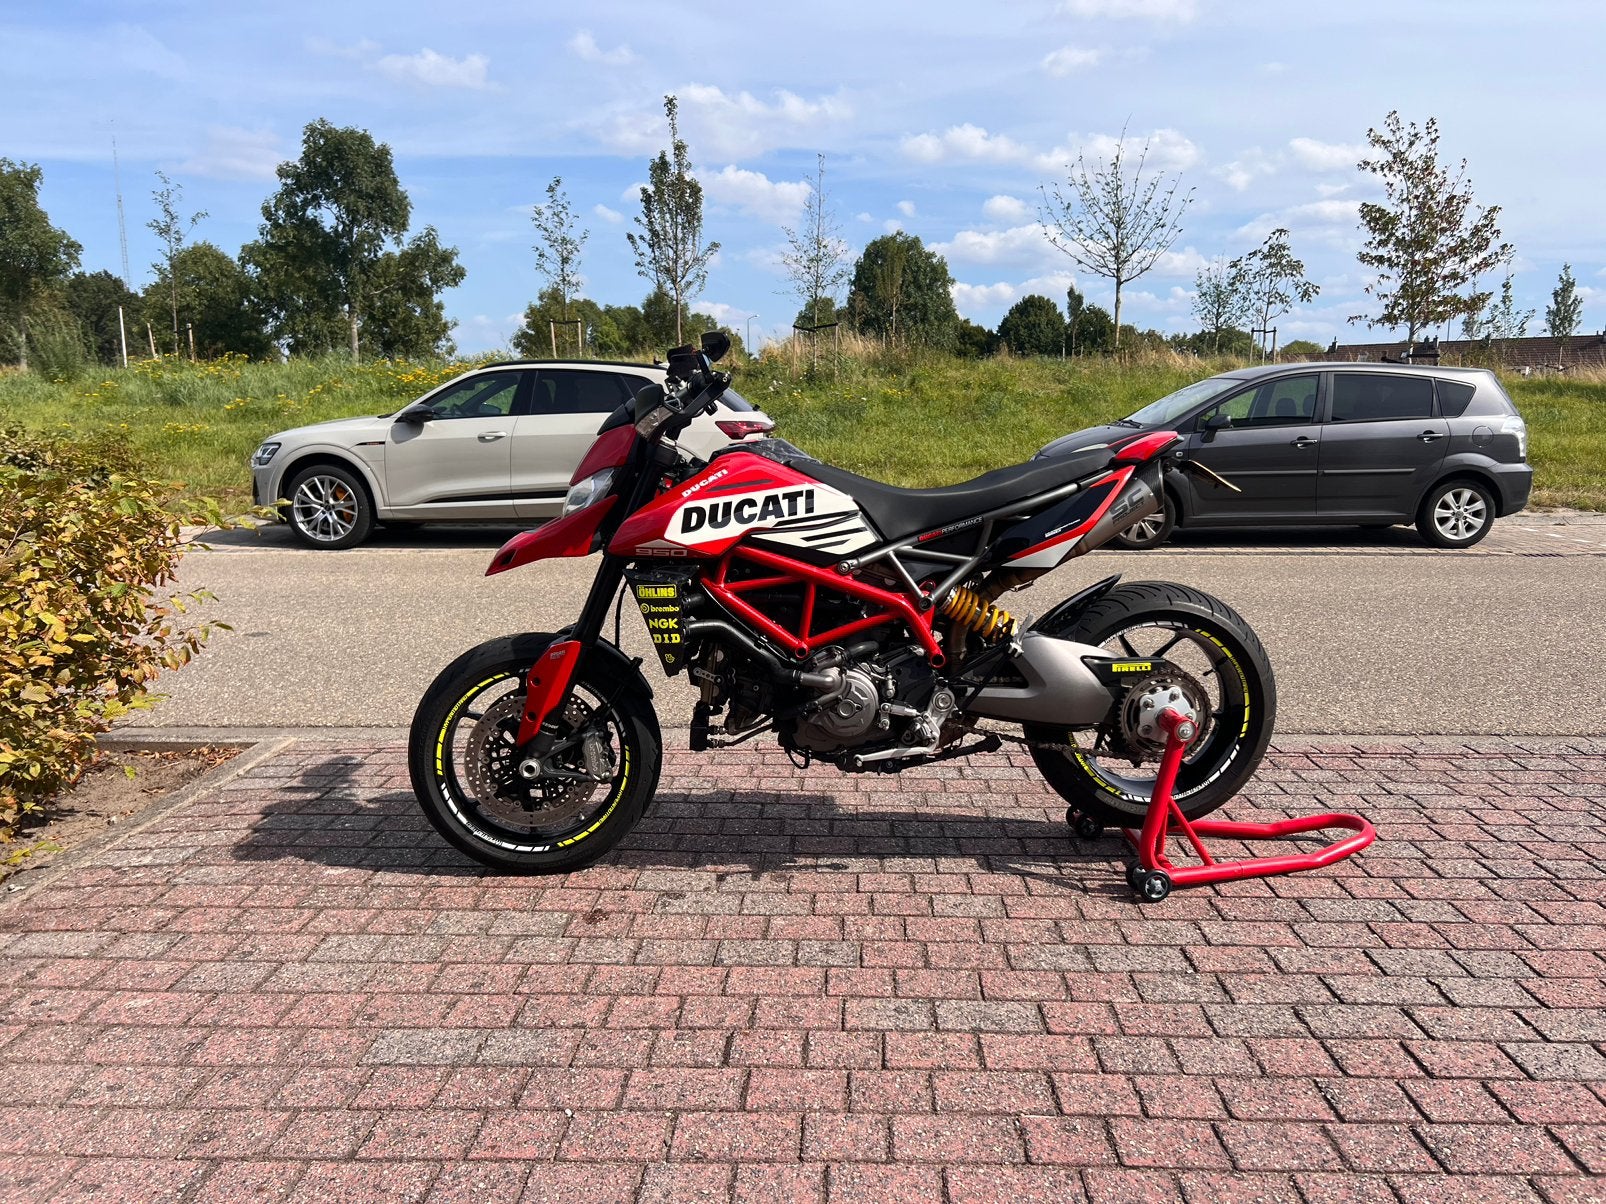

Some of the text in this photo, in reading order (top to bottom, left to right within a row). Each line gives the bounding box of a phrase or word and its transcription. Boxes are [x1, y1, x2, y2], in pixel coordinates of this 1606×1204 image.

[681, 468, 728, 498] DUCATI
[1109, 488, 1142, 516] SC
[681, 489, 815, 535] DUCATI
[635, 548, 688, 557] 950
[638, 586, 675, 597] ÖHLINS
[650, 605, 680, 613] brembo
[649, 618, 679, 629] NGK
[1112, 662, 1152, 673] PIRELLI
